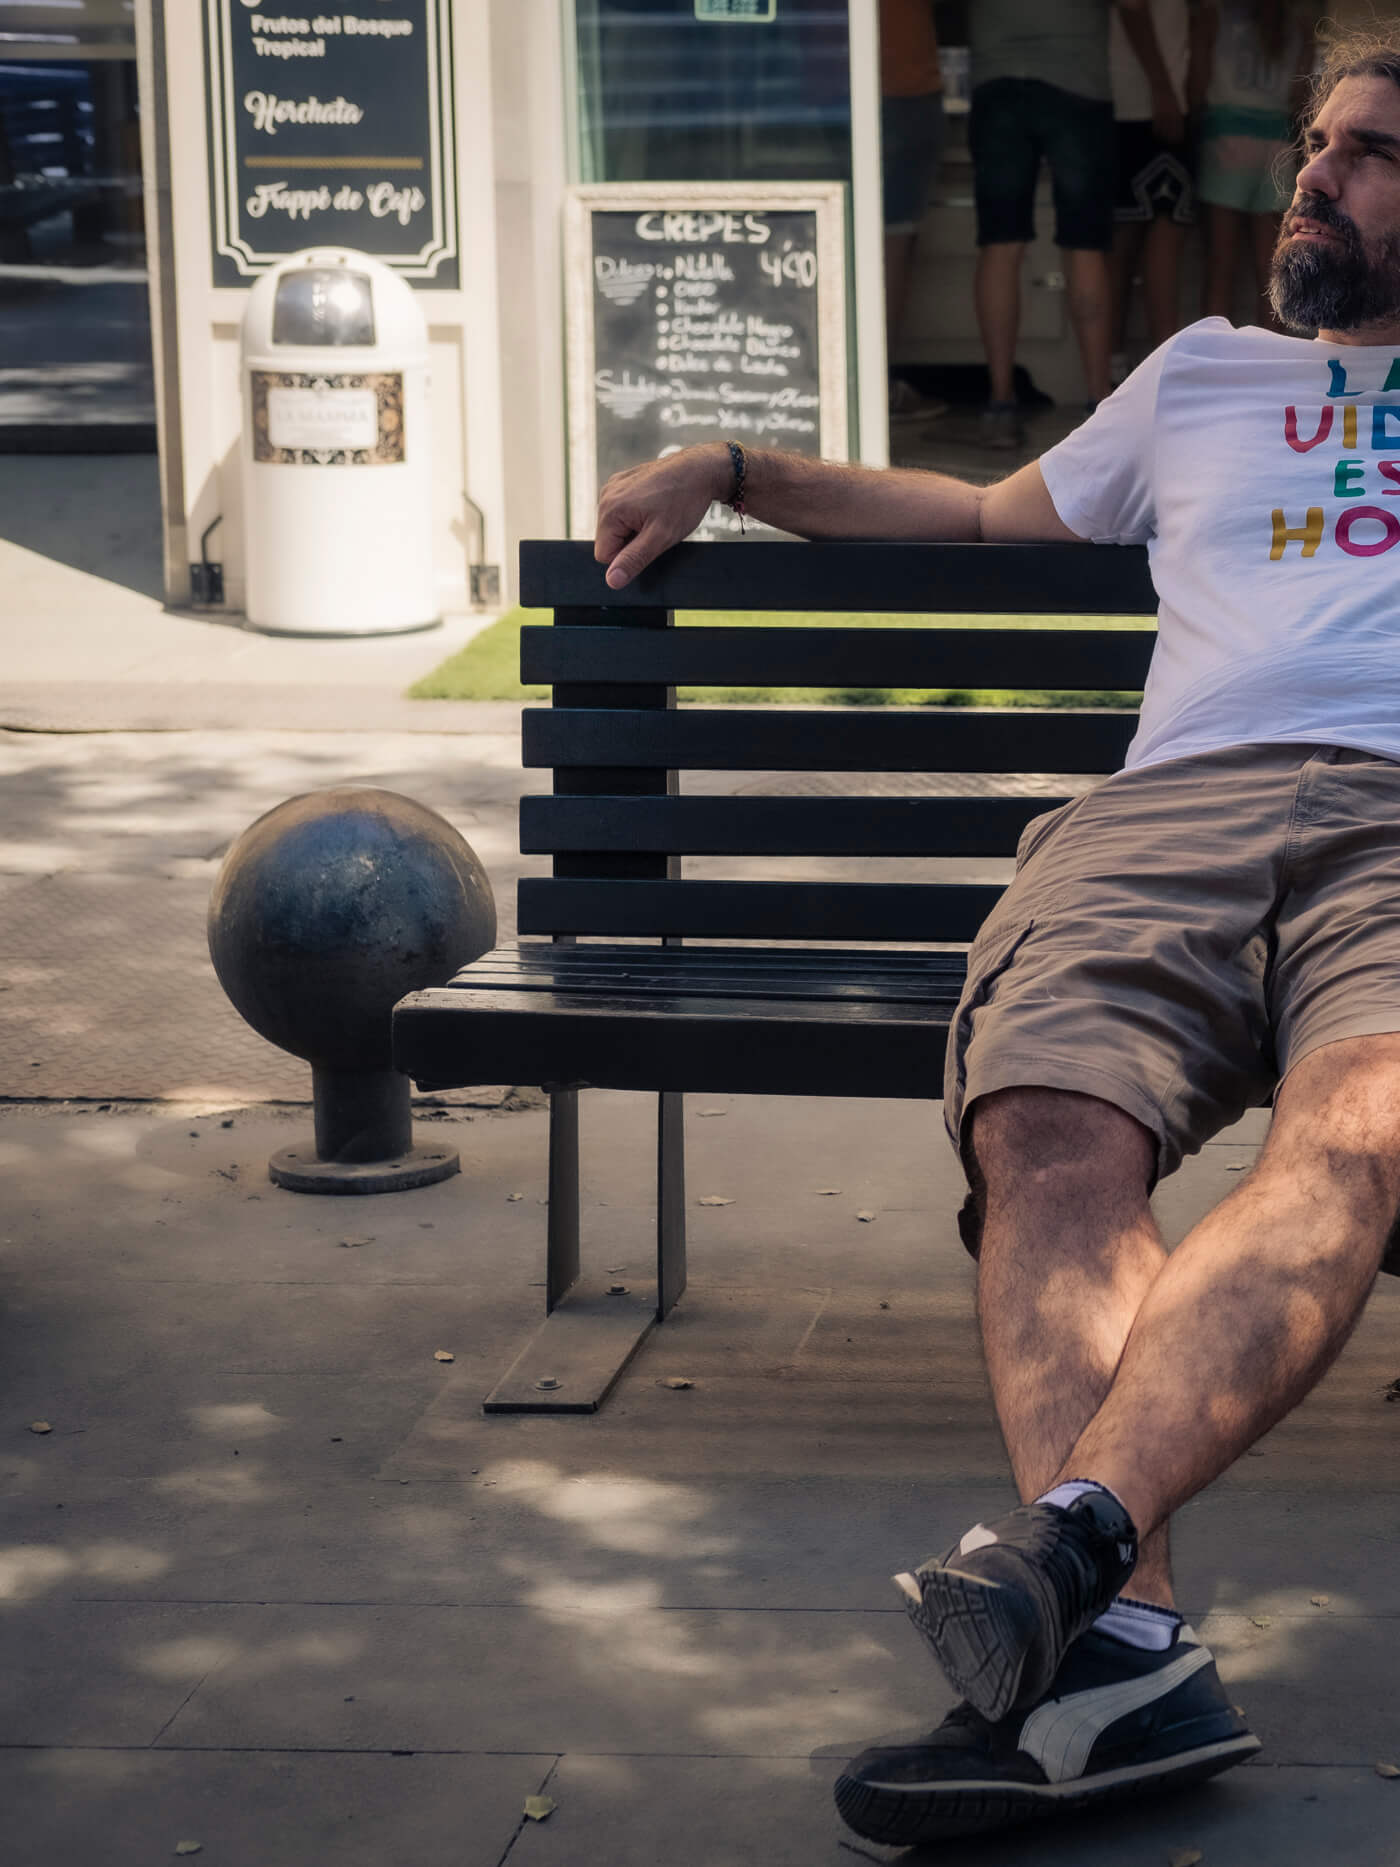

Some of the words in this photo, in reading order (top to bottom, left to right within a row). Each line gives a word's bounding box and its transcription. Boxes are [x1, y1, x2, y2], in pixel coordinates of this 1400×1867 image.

[251, 15, 310, 34] Frutos
[312, 16, 341, 34] del
[344, 16, 413, 38] Bosque
[252, 38, 325, 59] Tropical
[244, 91, 364, 135] Horchata
[333, 186, 363, 210] de
[635, 212, 771, 243] CREPES
